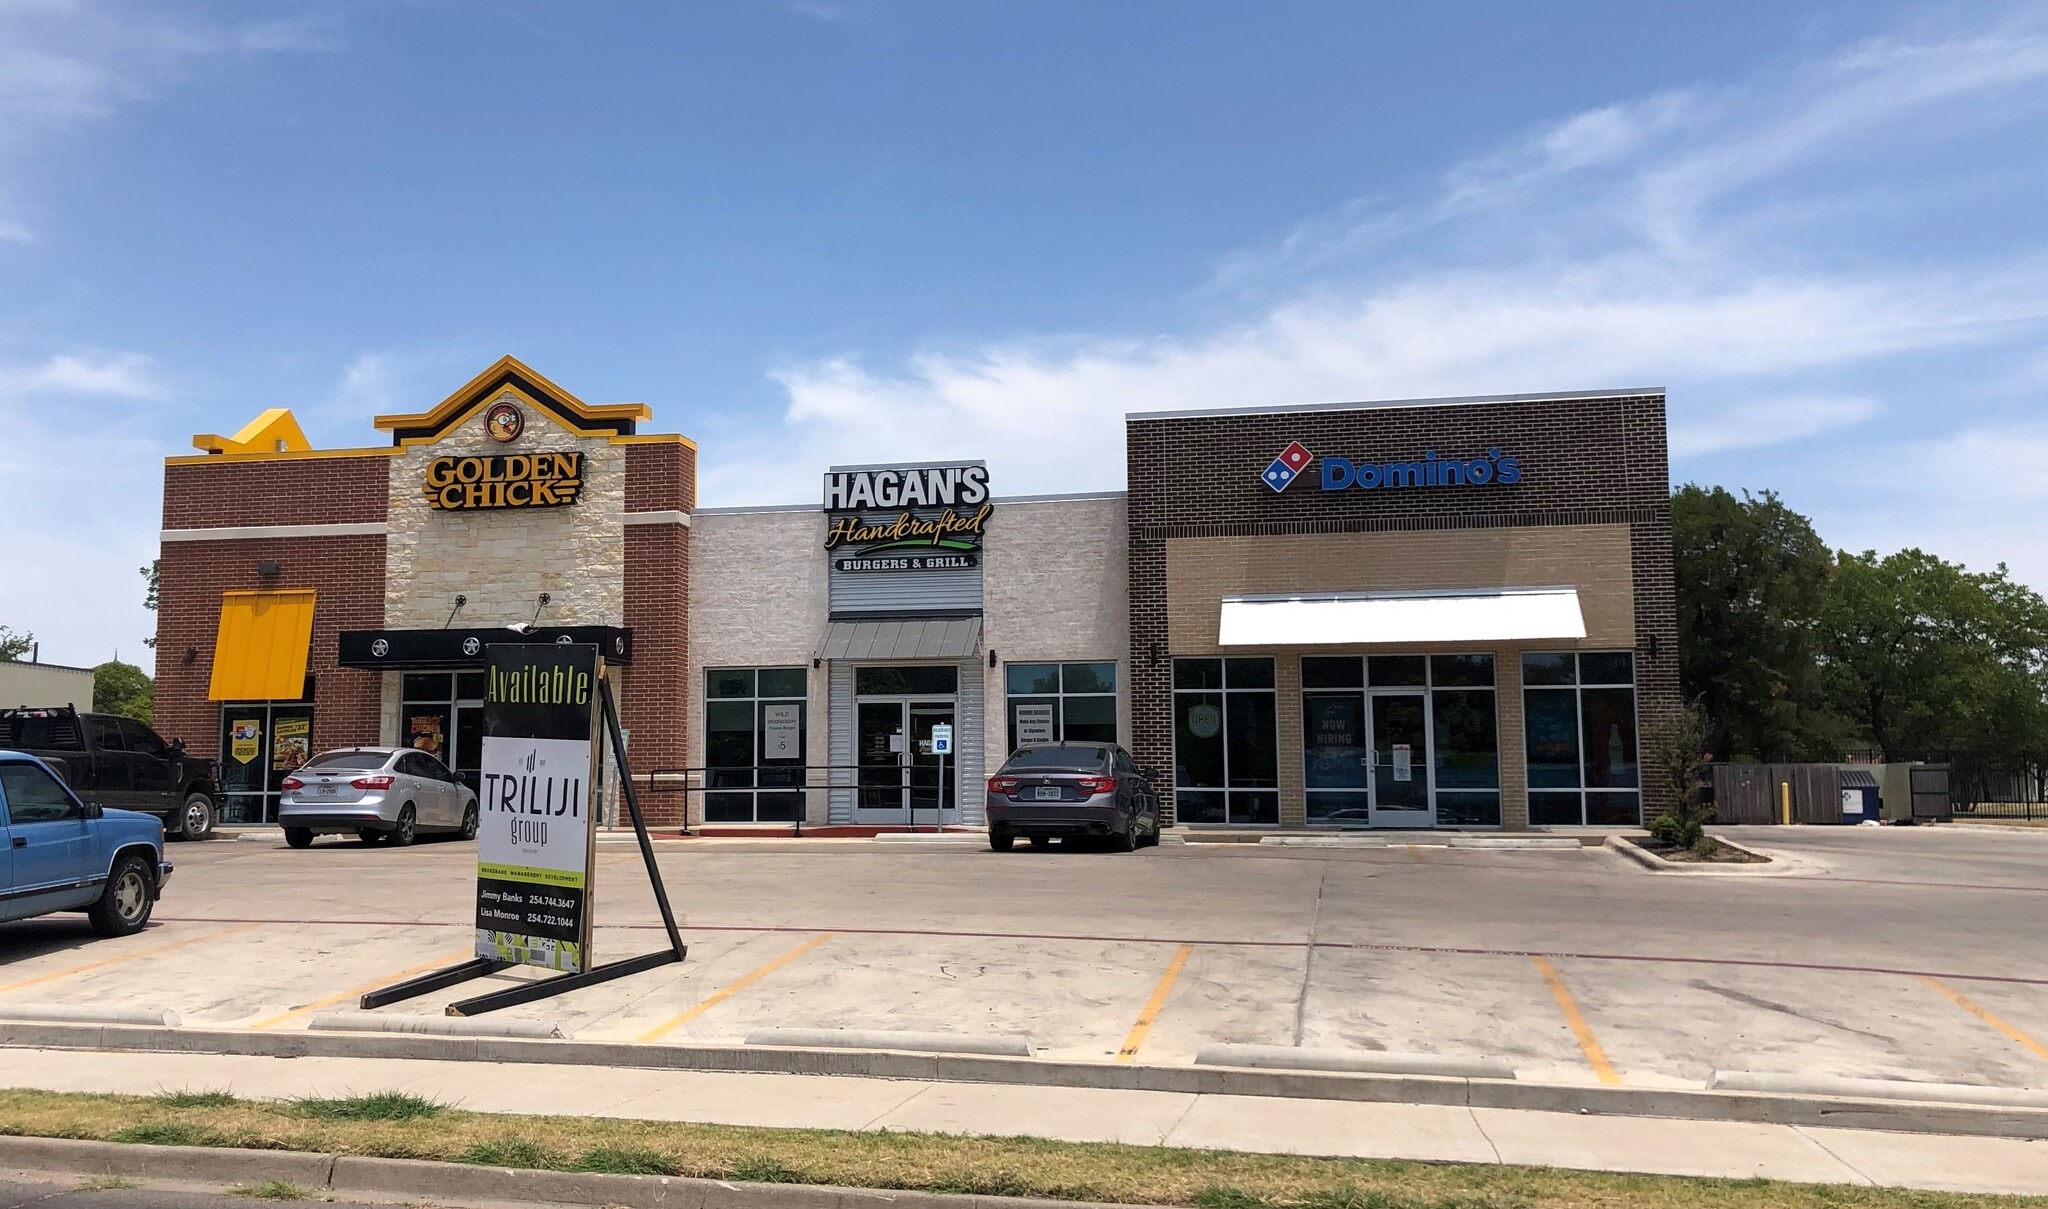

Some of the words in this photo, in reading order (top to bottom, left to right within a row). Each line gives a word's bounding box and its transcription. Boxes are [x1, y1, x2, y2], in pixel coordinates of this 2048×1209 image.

[427, 452, 580, 487] GOLDEN
[1321, 447, 1522, 491] Domino's
[439, 480, 562, 509] CHICK
[824, 466, 989, 509] HAGAN'S
[824, 504, 993, 548] Handcrafted
[842, 558, 908, 571] BURGERS
[912, 557, 922, 569] &
[926, 556, 969, 569] GRILL
[488, 664, 589, 705] Available
[1191, 713, 1217, 725] OPEN
[1322, 719, 1346, 730] NOW
[1317, 733, 1352, 744] HIRING
[485, 773, 580, 818] TRILIJI
[510, 816, 548, 847] group
[481, 867, 507, 875] BROKERAGE
[510, 870, 542, 879] MANAGEMENT
[544, 873, 578, 882] DEVELOPMENT
[480, 889, 502, 903] Jimmy
[502, 891, 523, 903] Banks
[529, 894, 575, 909] 254.744.3647
[480, 907, 493, 917] Lisa
[493, 908, 520, 921] Monroe
[526, 913, 574, 928] 254.722.1044
